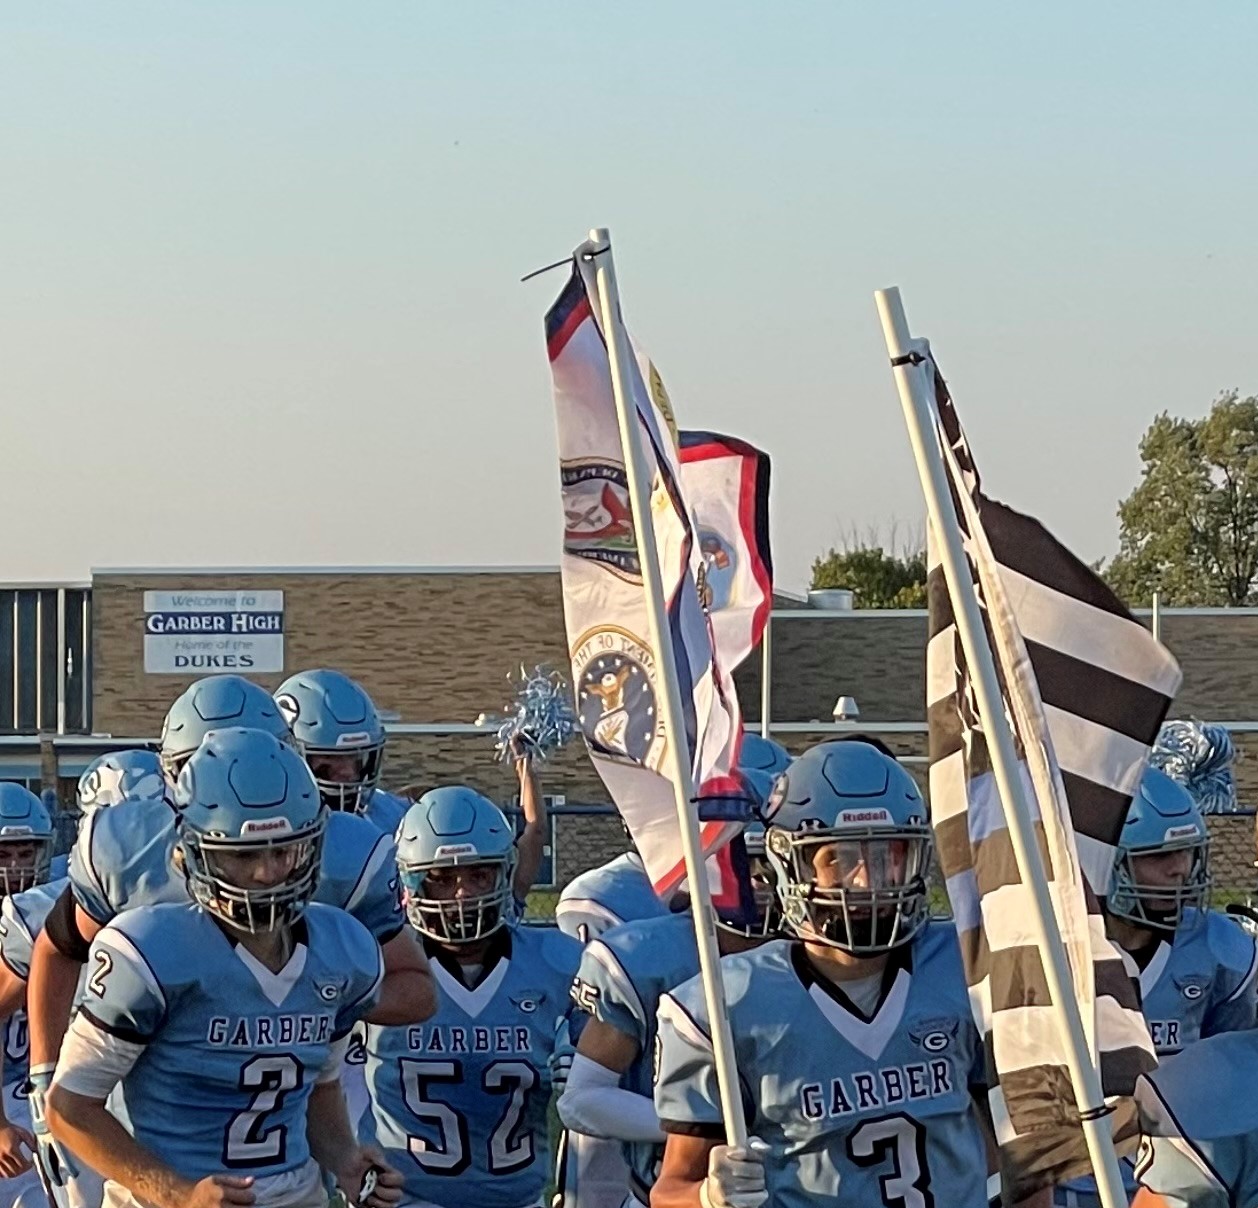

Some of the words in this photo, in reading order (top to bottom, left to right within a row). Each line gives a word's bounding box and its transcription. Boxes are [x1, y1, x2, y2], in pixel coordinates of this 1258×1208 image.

[172, 595, 236, 607] Welcome
[241, 595, 256, 607] to
[147, 613, 225, 632] GARBER
[231, 613, 280, 632] HIGH
[175, 640, 213, 650] Home
[216, 639, 230, 650] of
[233, 639, 253, 650] the
[174, 654, 254, 668] DUKES
[843, 809, 887, 822] Riddell
[89, 949, 112, 999] 2
[208, 1015, 333, 1048] GARBER
[405, 1025, 535, 1053] GARBER
[800, 1059, 953, 1120] GARBER
[222, 1052, 304, 1168] 2
[398, 1057, 541, 1176] 52
